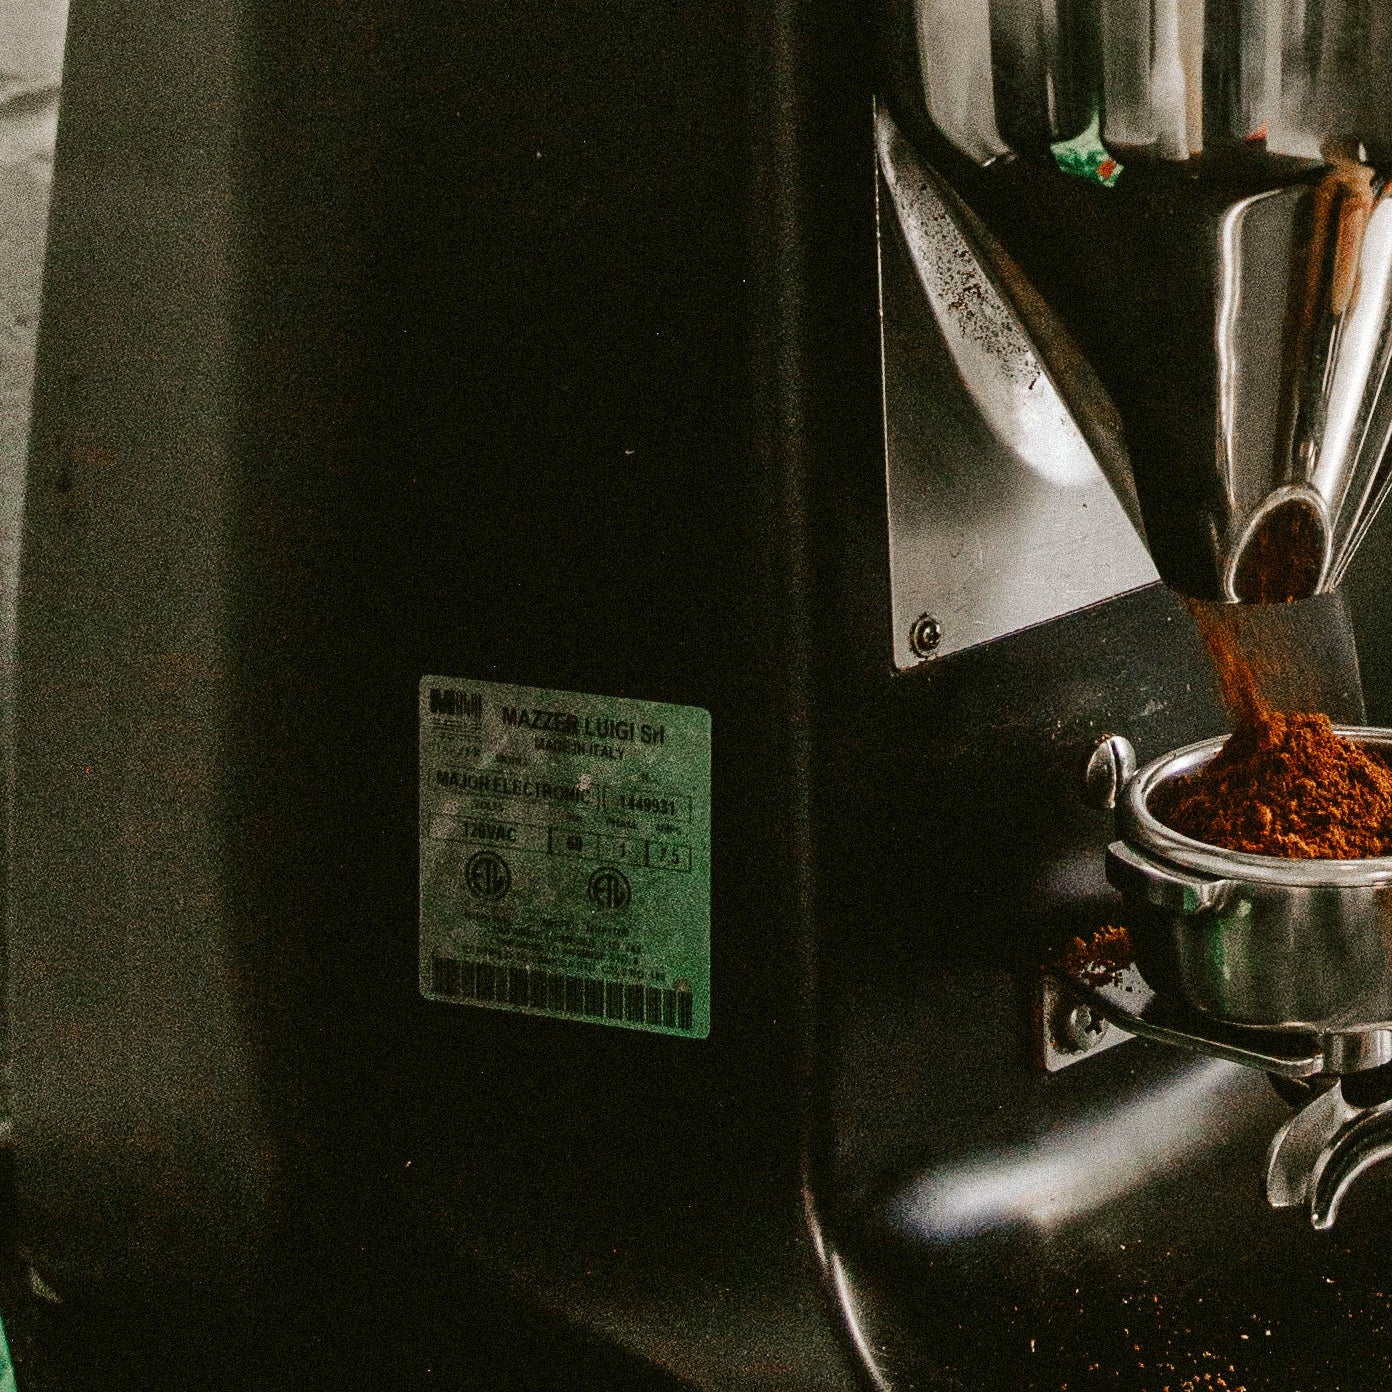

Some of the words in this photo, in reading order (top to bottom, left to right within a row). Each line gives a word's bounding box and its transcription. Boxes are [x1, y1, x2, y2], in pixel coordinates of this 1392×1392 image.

[502, 707, 579, 735] MAZZER
[584, 717, 635, 743] LUIGI
[588, 744, 625, 760] ITALY
